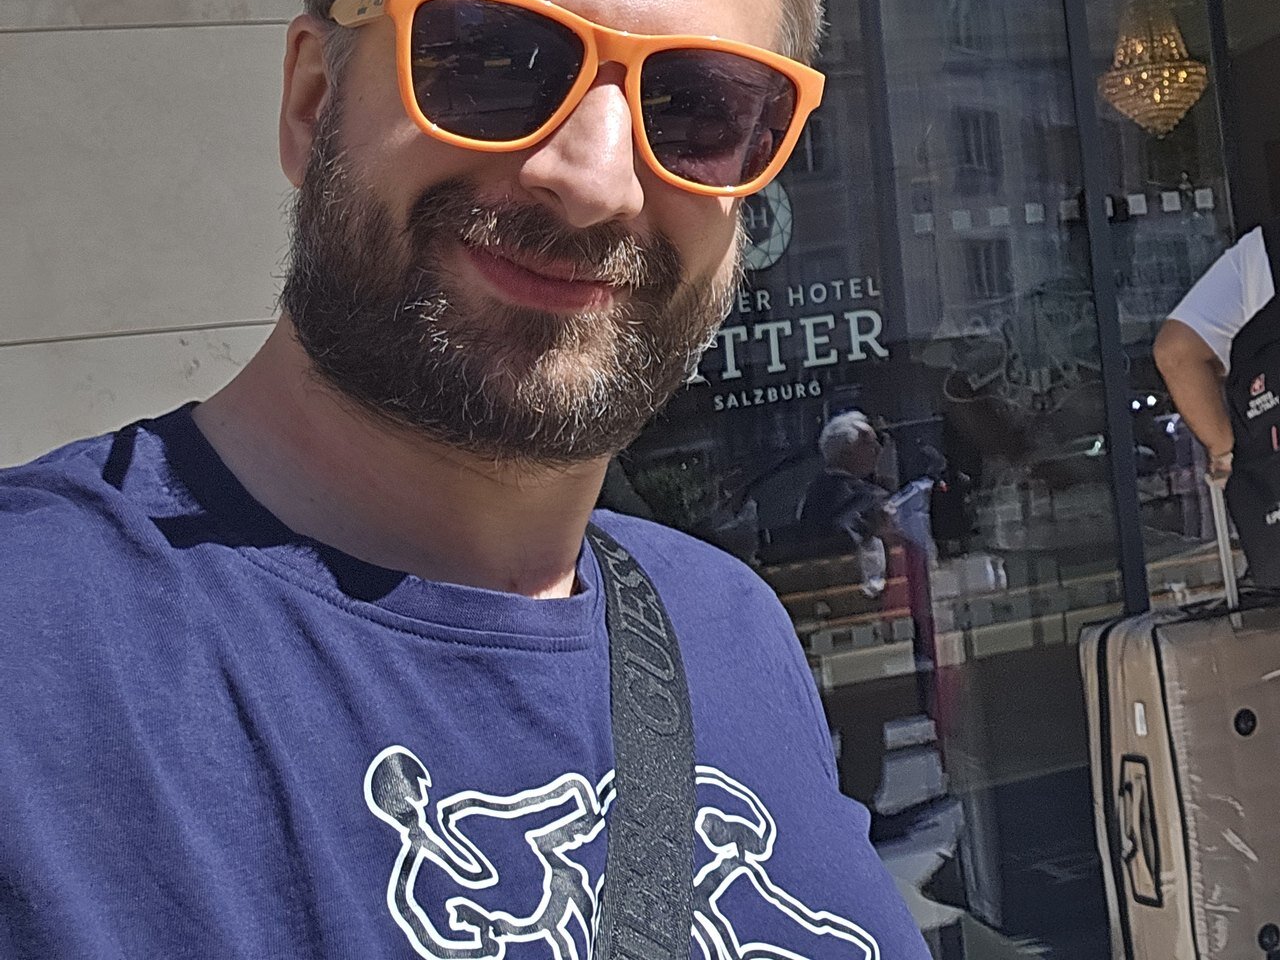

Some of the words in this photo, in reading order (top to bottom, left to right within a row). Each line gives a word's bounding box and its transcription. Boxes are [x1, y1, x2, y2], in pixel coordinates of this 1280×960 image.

[787, 276, 881, 308] HOTEL
[690, 309, 889, 385] TTER
[712, 380, 822, 412] SALZBURG
